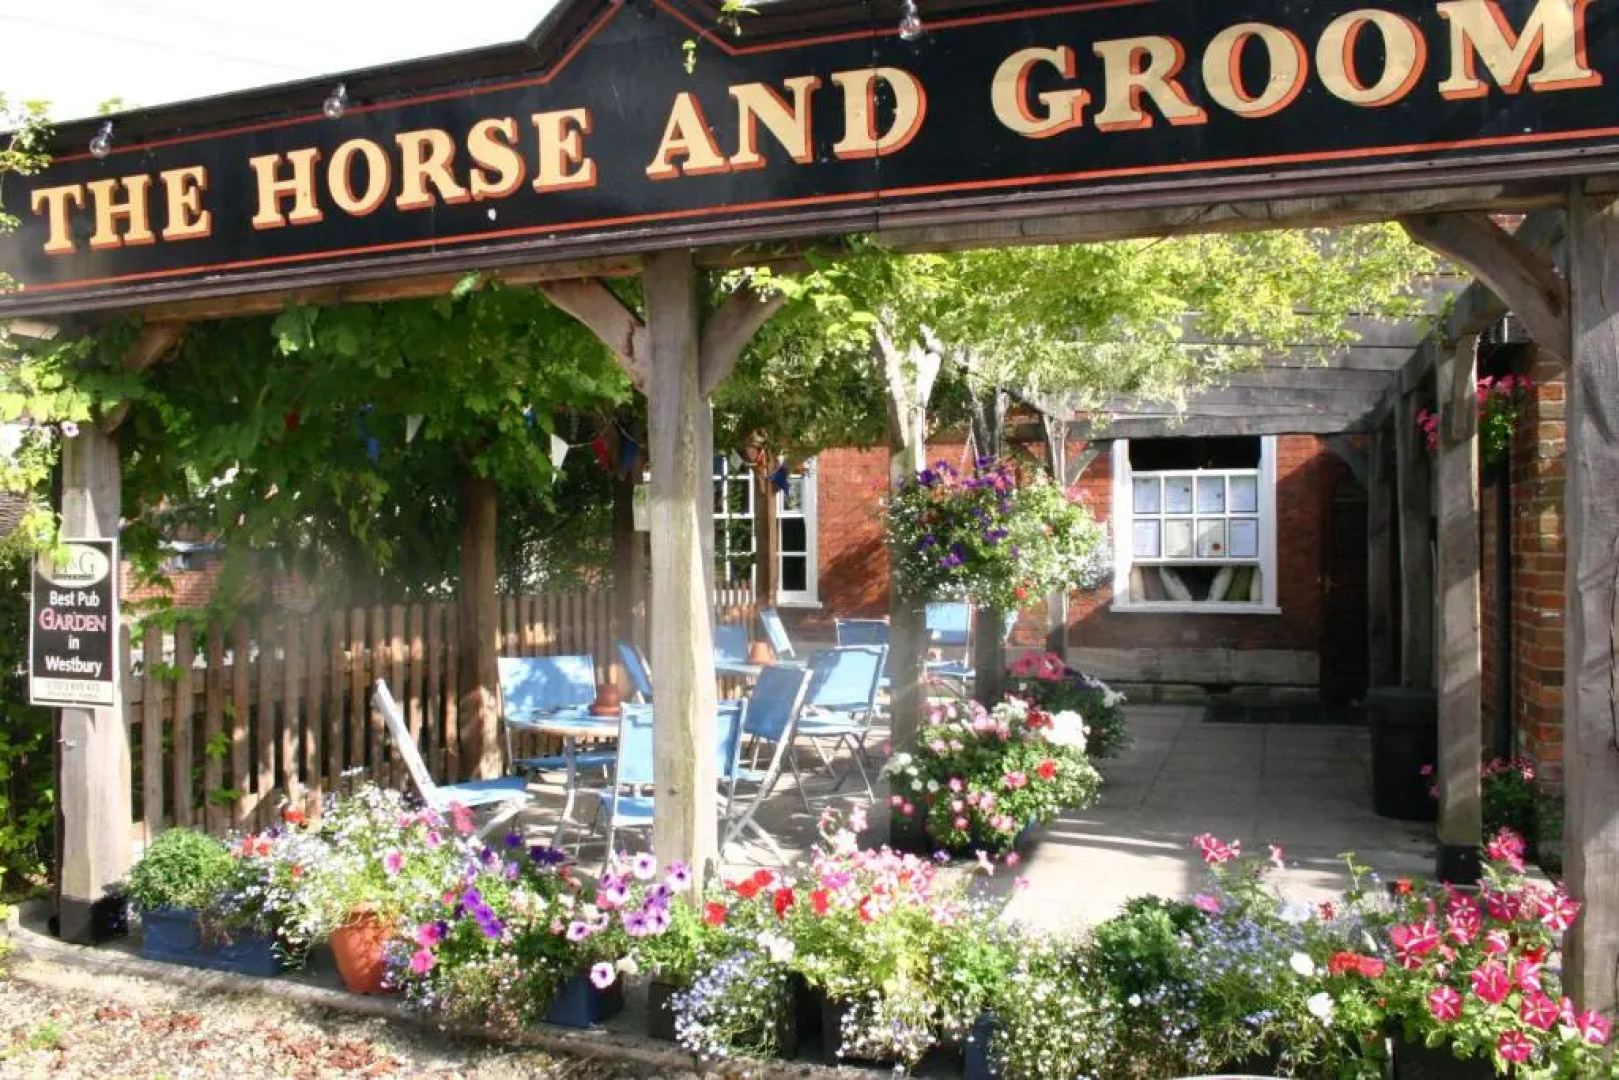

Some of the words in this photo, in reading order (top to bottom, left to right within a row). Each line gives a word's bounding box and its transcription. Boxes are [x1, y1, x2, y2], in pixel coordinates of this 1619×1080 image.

[31, 165, 212, 254] THE
[249, 107, 597, 231] HORSE
[645, 66, 928, 180] AND
[991, 0, 1603, 139] GROOM
[50, 590, 75, 606] Best
[78, 591, 100, 607] Pub
[38, 607, 107, 632] GARDEN
[68, 634, 80, 650] in
[44, 655, 102, 678] Westbury
